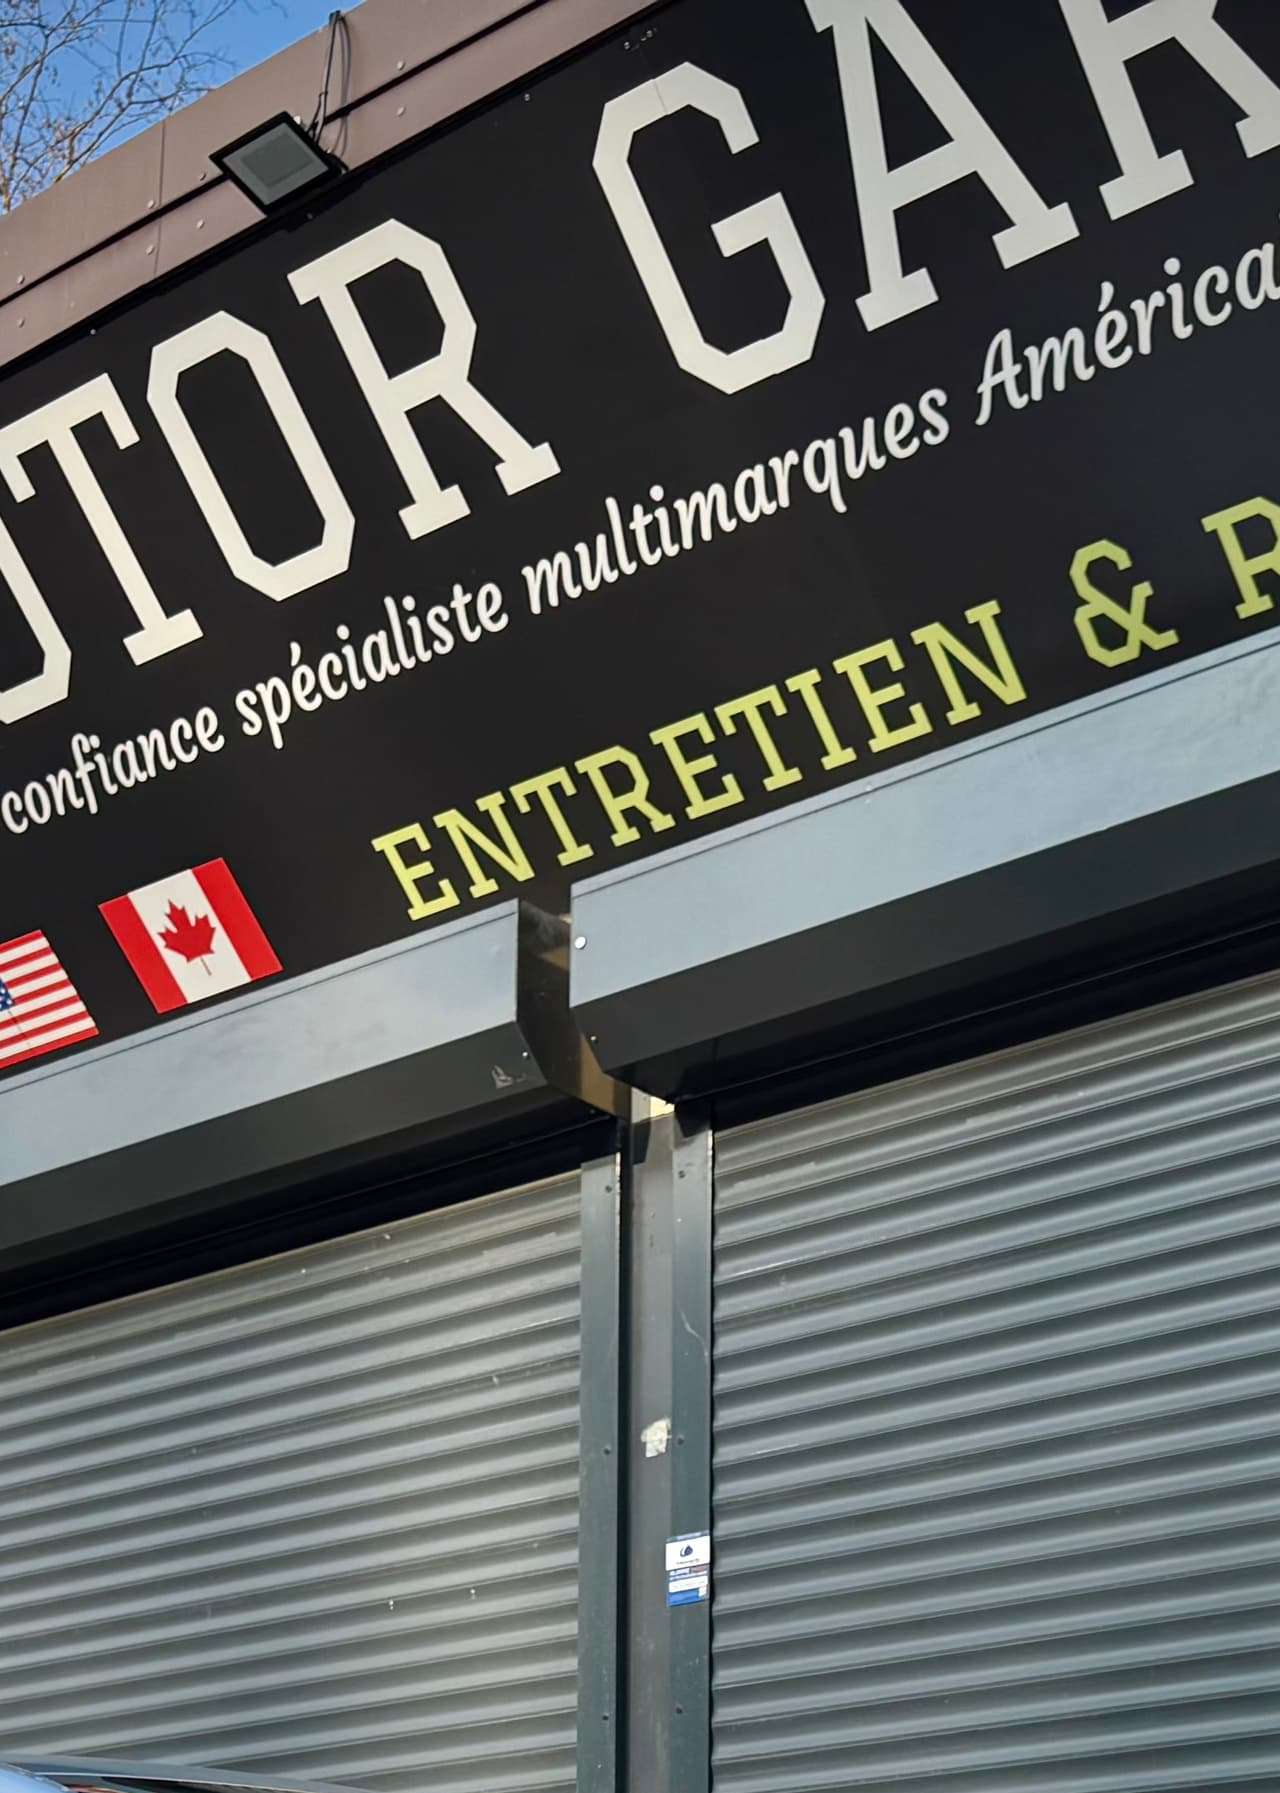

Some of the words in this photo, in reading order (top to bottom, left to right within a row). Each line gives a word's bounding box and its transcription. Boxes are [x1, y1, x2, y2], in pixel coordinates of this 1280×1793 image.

[0, 702, 224, 827] confiance
[239, 577, 509, 749] spécialiste
[521, 388, 950, 616] multimarques
[371, 600, 1029, 921] ENTRETIEN
[1068, 539, 1180, 668] &
